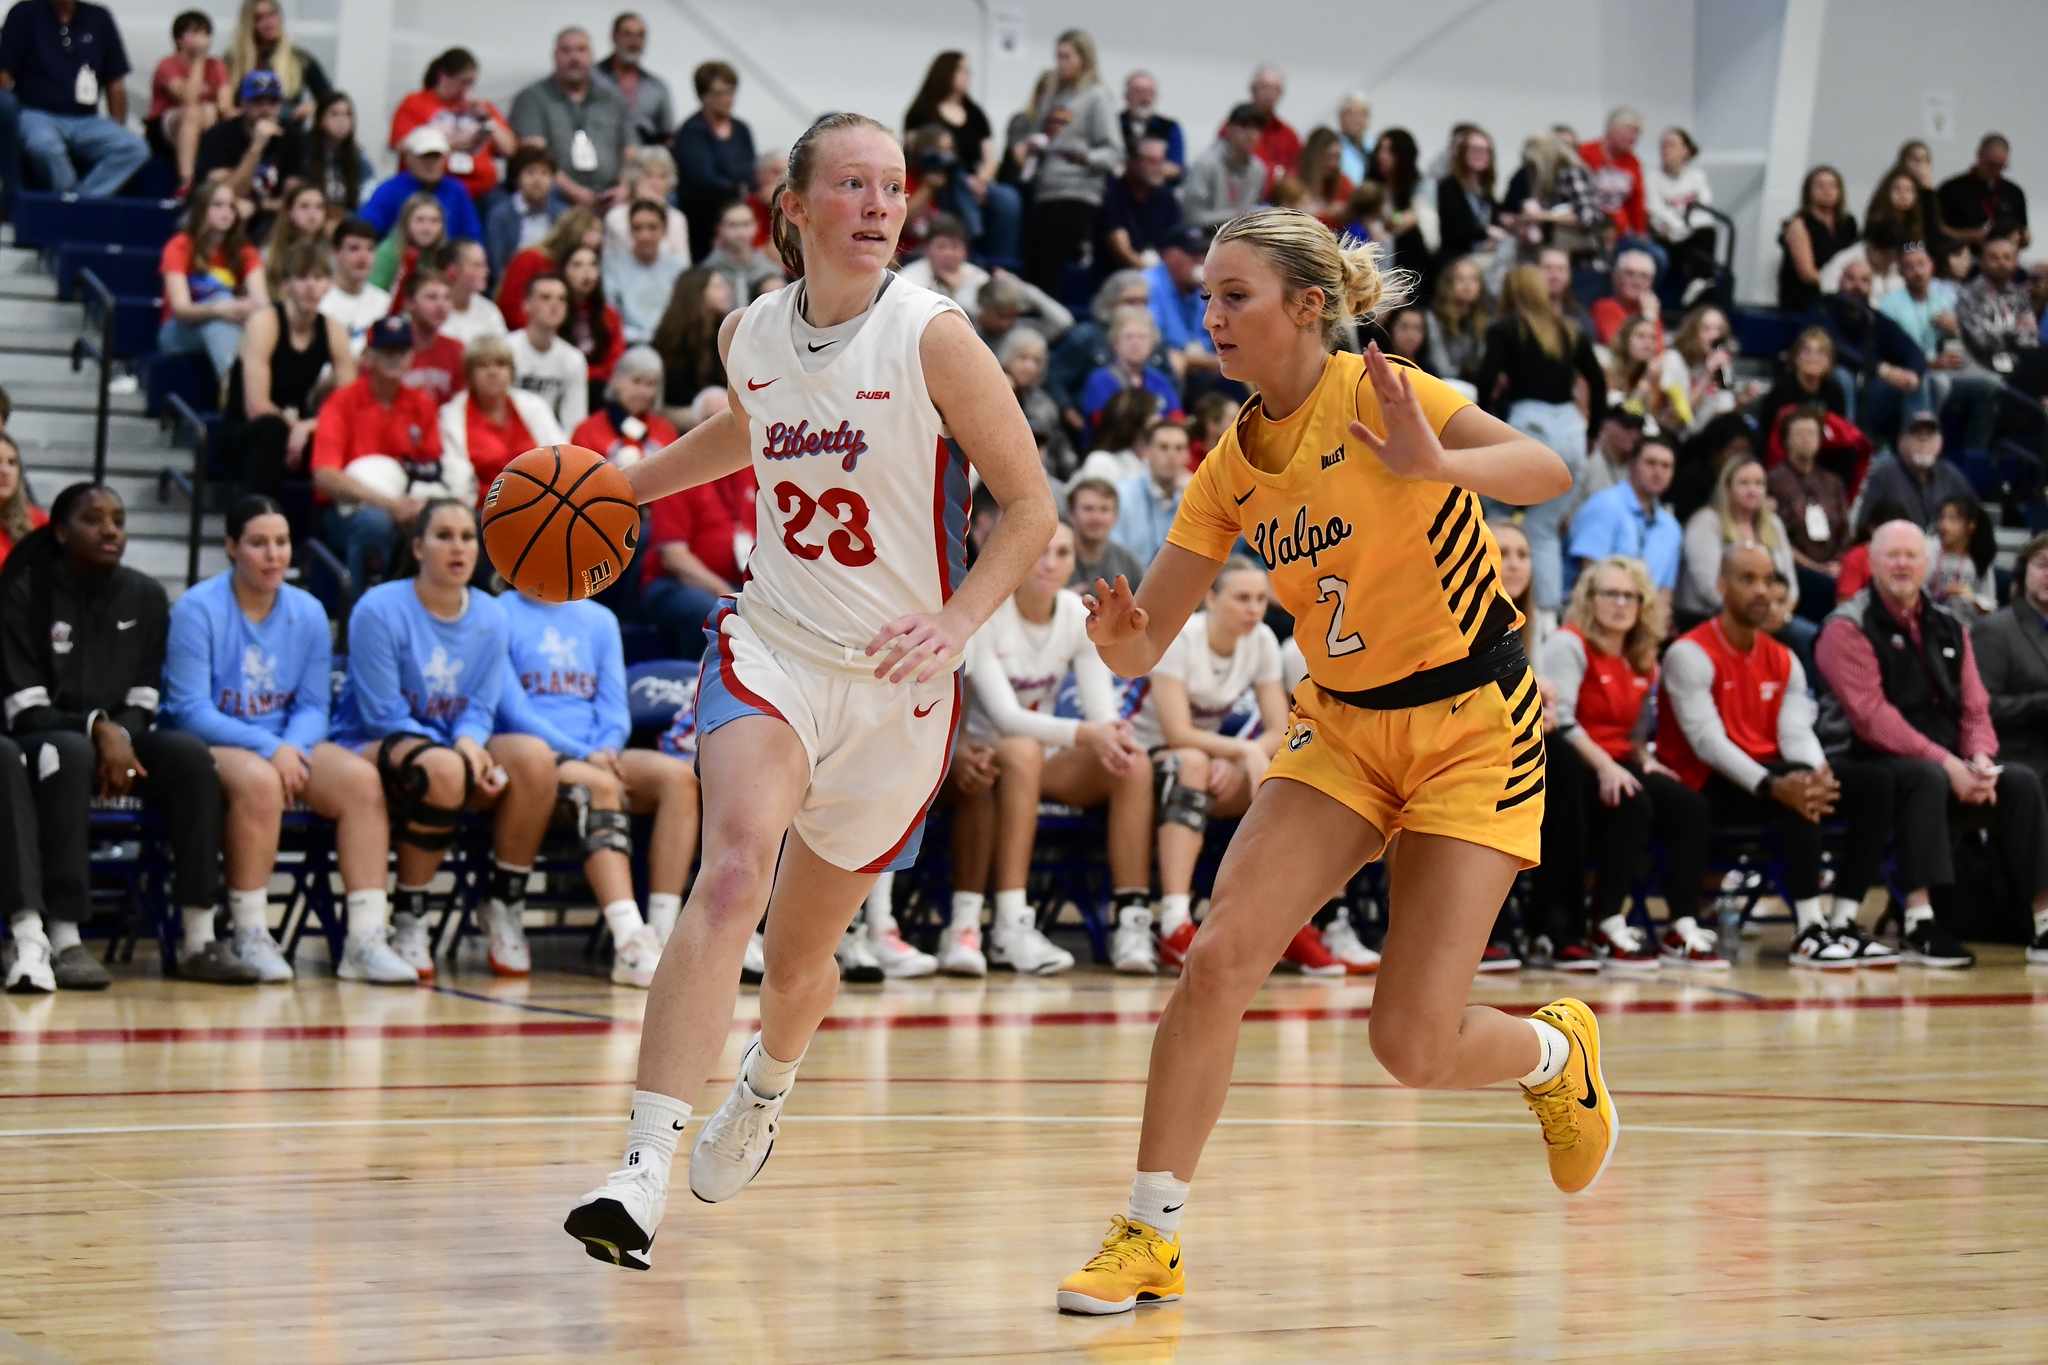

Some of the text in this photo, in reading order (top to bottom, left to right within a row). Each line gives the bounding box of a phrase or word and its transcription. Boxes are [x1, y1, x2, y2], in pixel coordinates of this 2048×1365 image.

[763, 420, 868, 472] Liberty
[773, 481, 877, 567] 23
[1254, 505, 1353, 571] Valpo
[1315, 574, 1366, 658] 2
